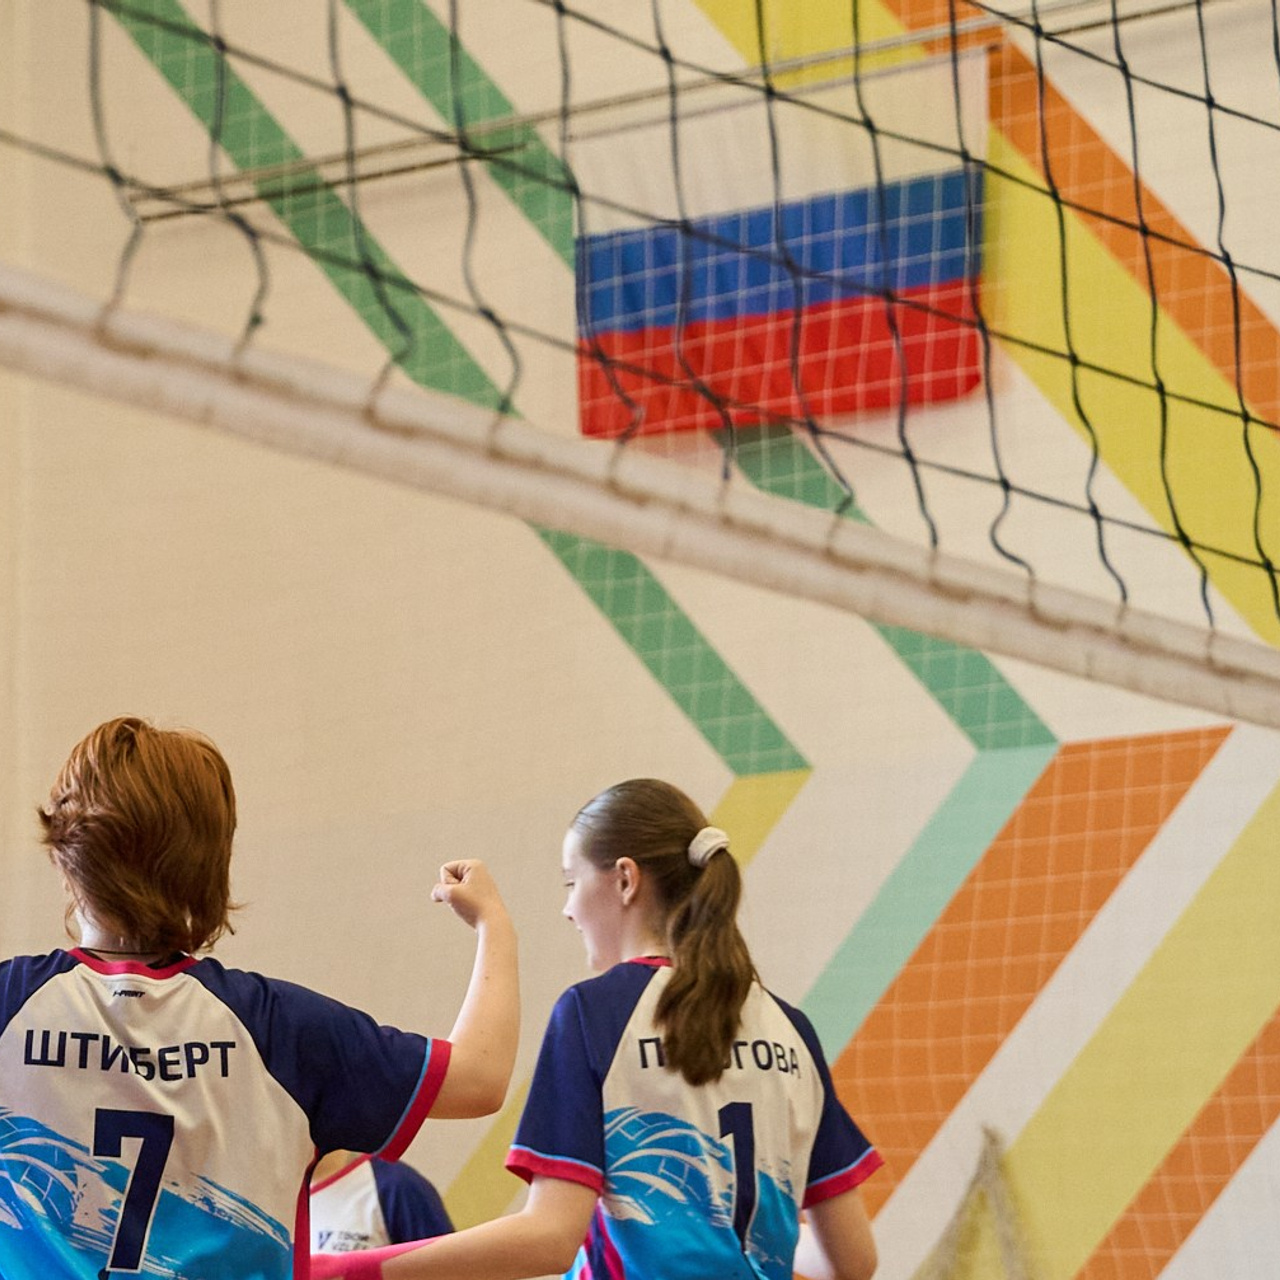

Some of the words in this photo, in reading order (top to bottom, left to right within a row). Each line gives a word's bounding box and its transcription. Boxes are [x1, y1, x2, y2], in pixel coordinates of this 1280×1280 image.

[23, 1029, 236, 1081] ШТИБЕРТ
[638, 1037, 802, 1079] ПГОВА
[92, 1107, 176, 1271] 7
[718, 1101, 756, 1253] 1
